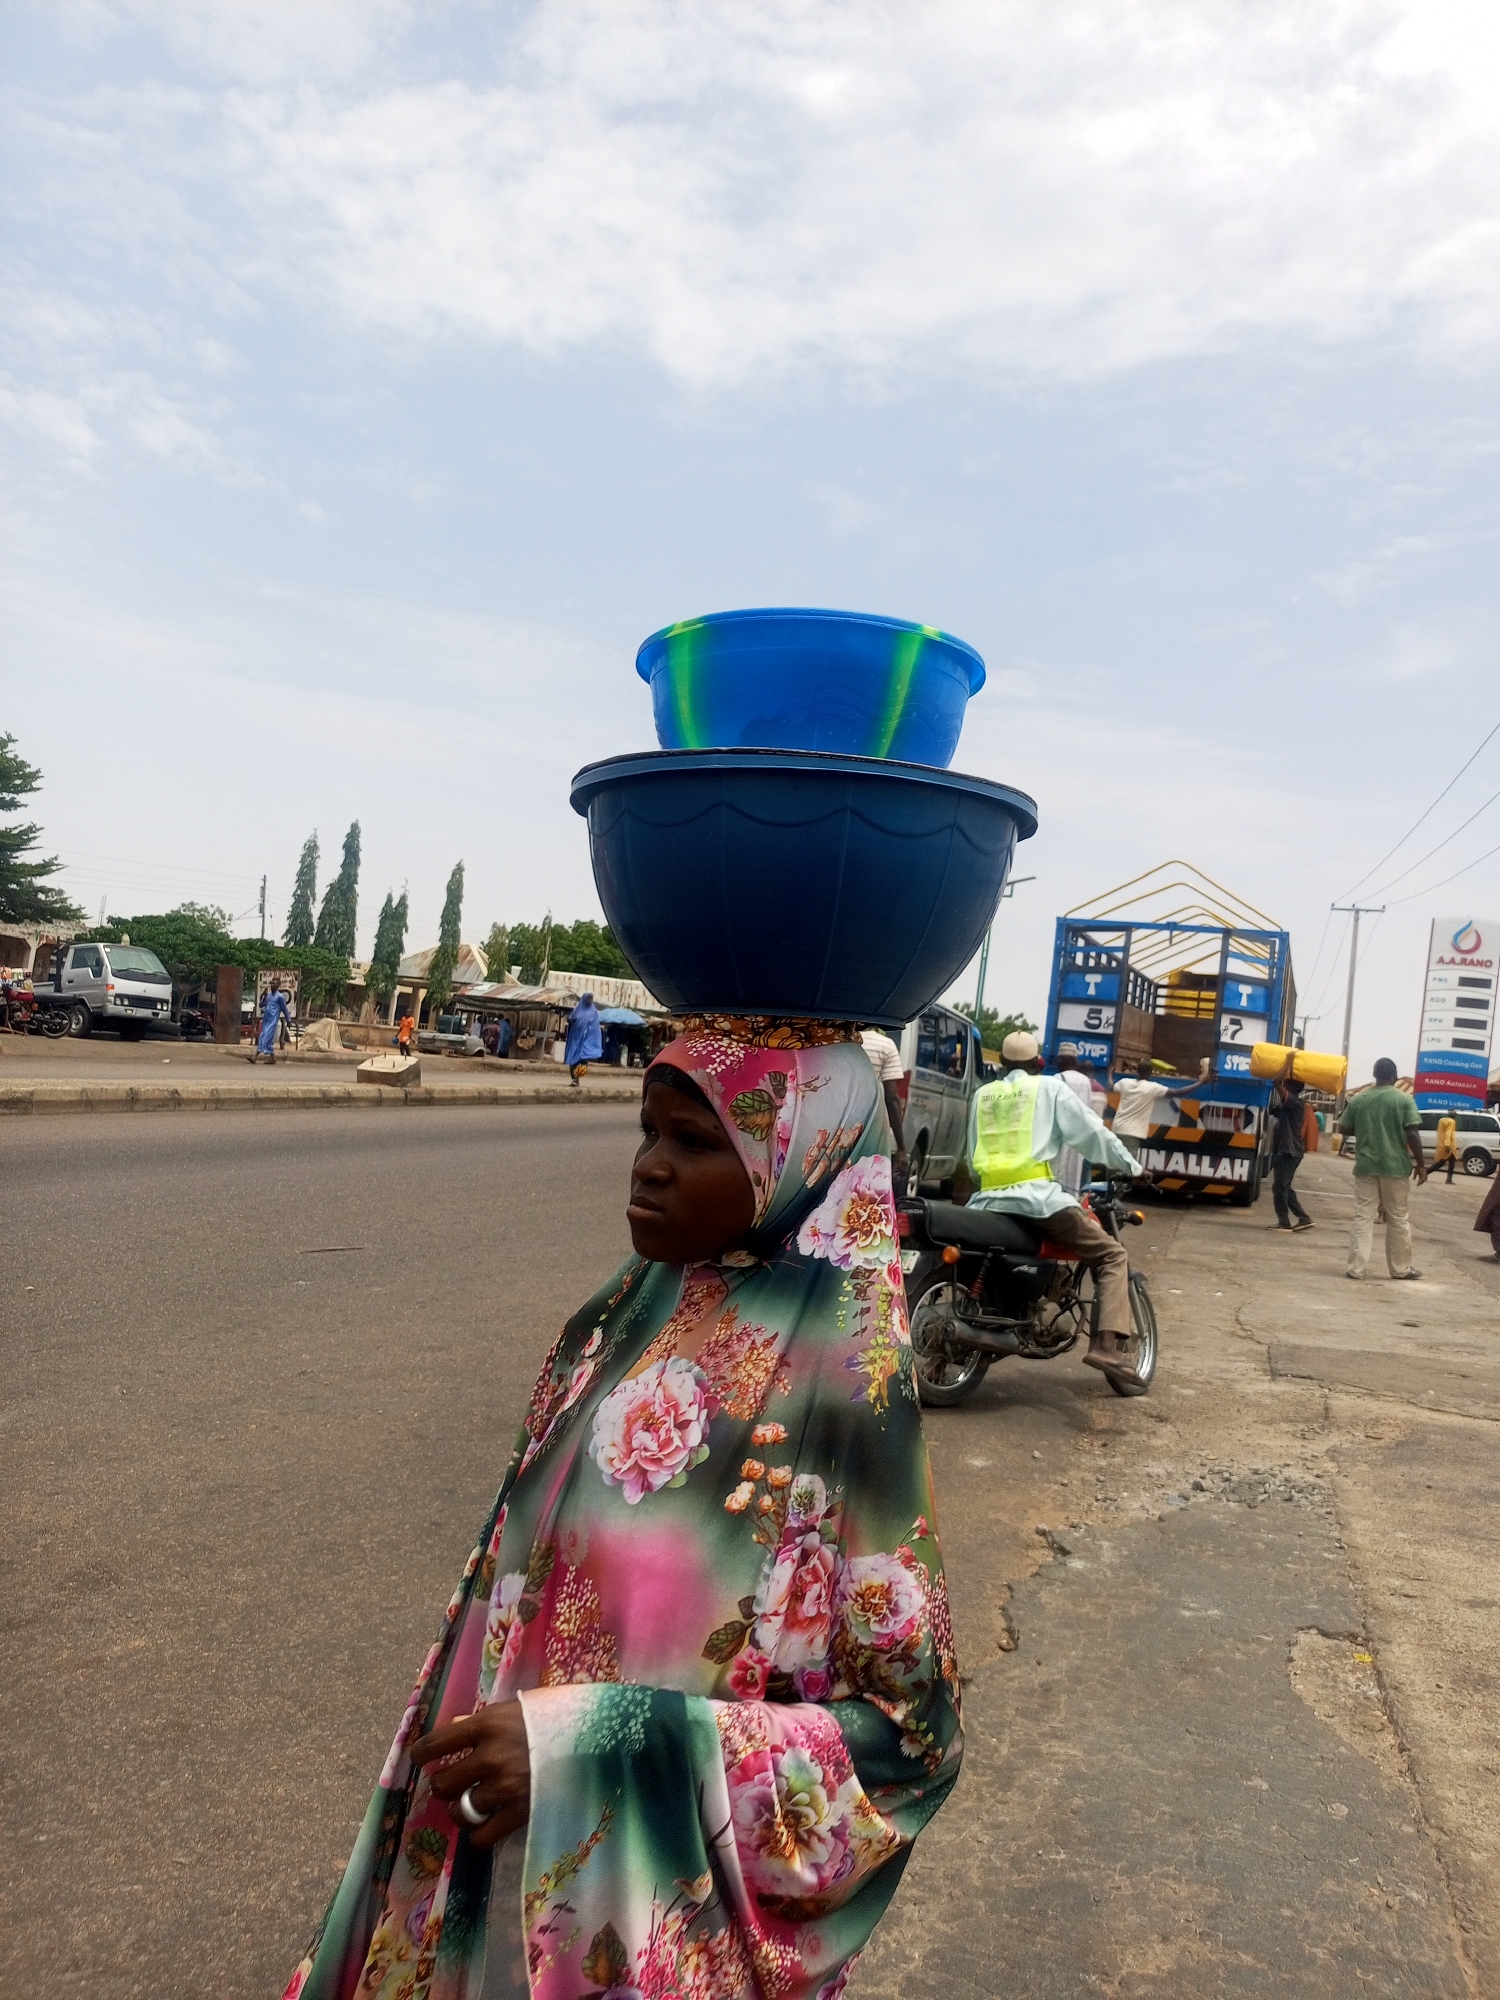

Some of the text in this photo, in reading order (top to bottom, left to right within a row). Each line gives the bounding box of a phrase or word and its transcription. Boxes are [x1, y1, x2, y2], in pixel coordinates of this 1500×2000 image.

[1436, 956, 1493, 968] A.A.RANO
[1084, 973, 1102, 996] T
[1238, 984, 1252, 1007] T
[1083, 1007, 1103, 1030] 5
[1228, 1017, 1243, 1041] 7
[1077, 1040, 1108, 1058] STOP
[1423, 1057, 1443, 1065] RANO
[1443, 1059, 1469, 1068] Cooking
[1446, 1080, 1477, 1088] Autocare
[1449, 1100, 1470, 1108] Lubes
